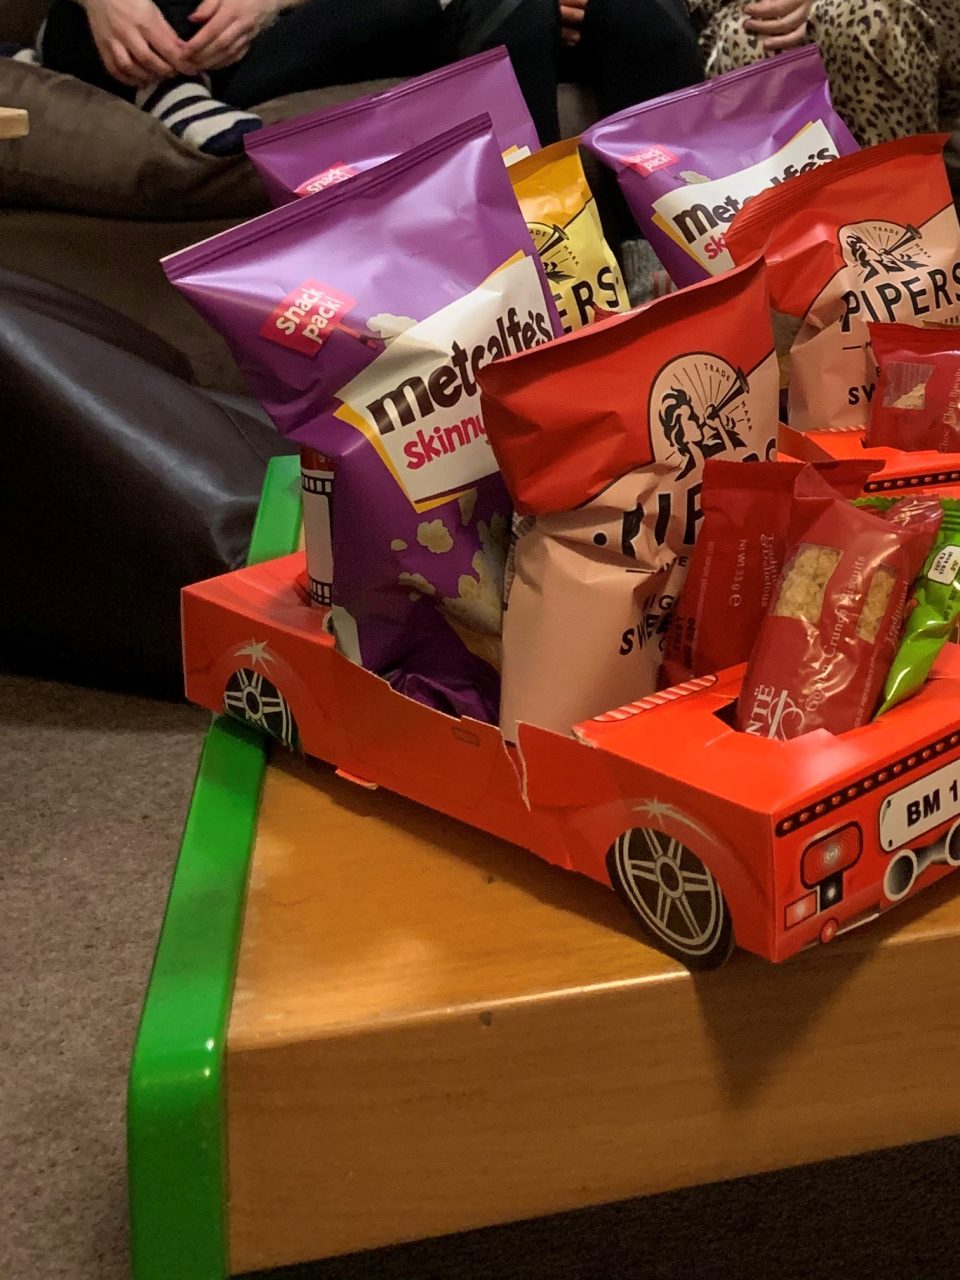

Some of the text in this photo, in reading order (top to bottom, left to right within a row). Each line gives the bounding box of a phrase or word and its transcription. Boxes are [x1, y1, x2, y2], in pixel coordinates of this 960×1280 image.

[872, 226, 899, 236] TRADE
[276, 287, 325, 335] snack
[302, 296, 344, 344] pack!
[704, 363, 731, 382] TRADE
[844, 556, 865, 606] iscuits
[907, 779, 958, 827] BM 1
